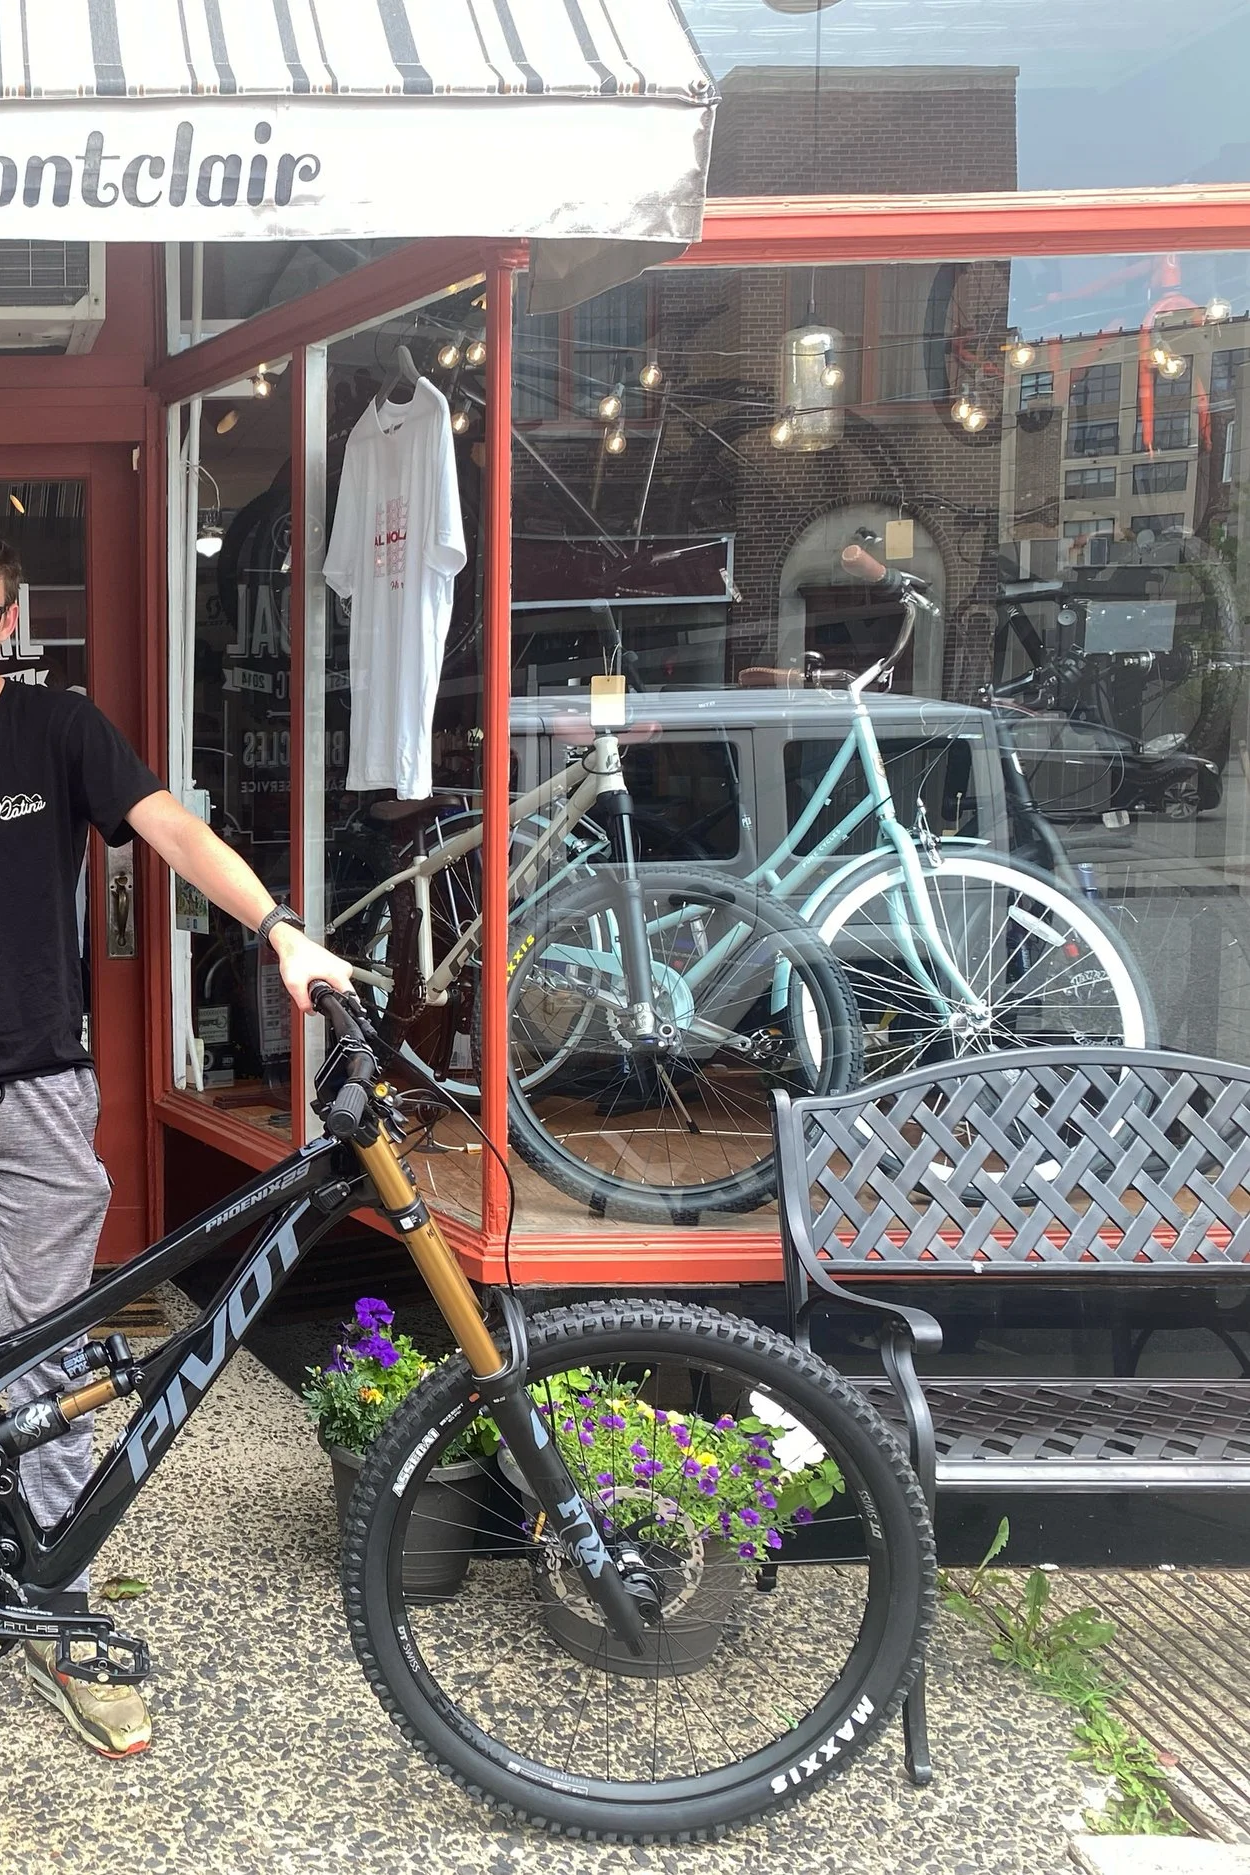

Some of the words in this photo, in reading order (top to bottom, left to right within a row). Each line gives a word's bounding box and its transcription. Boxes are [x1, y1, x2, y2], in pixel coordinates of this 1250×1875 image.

[204, 1179, 282, 1234] PHOENIX
[125, 1197, 312, 1485] PIVOT
[857, 1489, 878, 1520] SWISS
[868, 1522, 883, 1541] DT
[3, 1620, 60, 1634] ATLAS
[397, 1624, 408, 1642] DT
[402, 1643, 422, 1674] SWISS
[770, 1694, 875, 1795] MAXXIS
